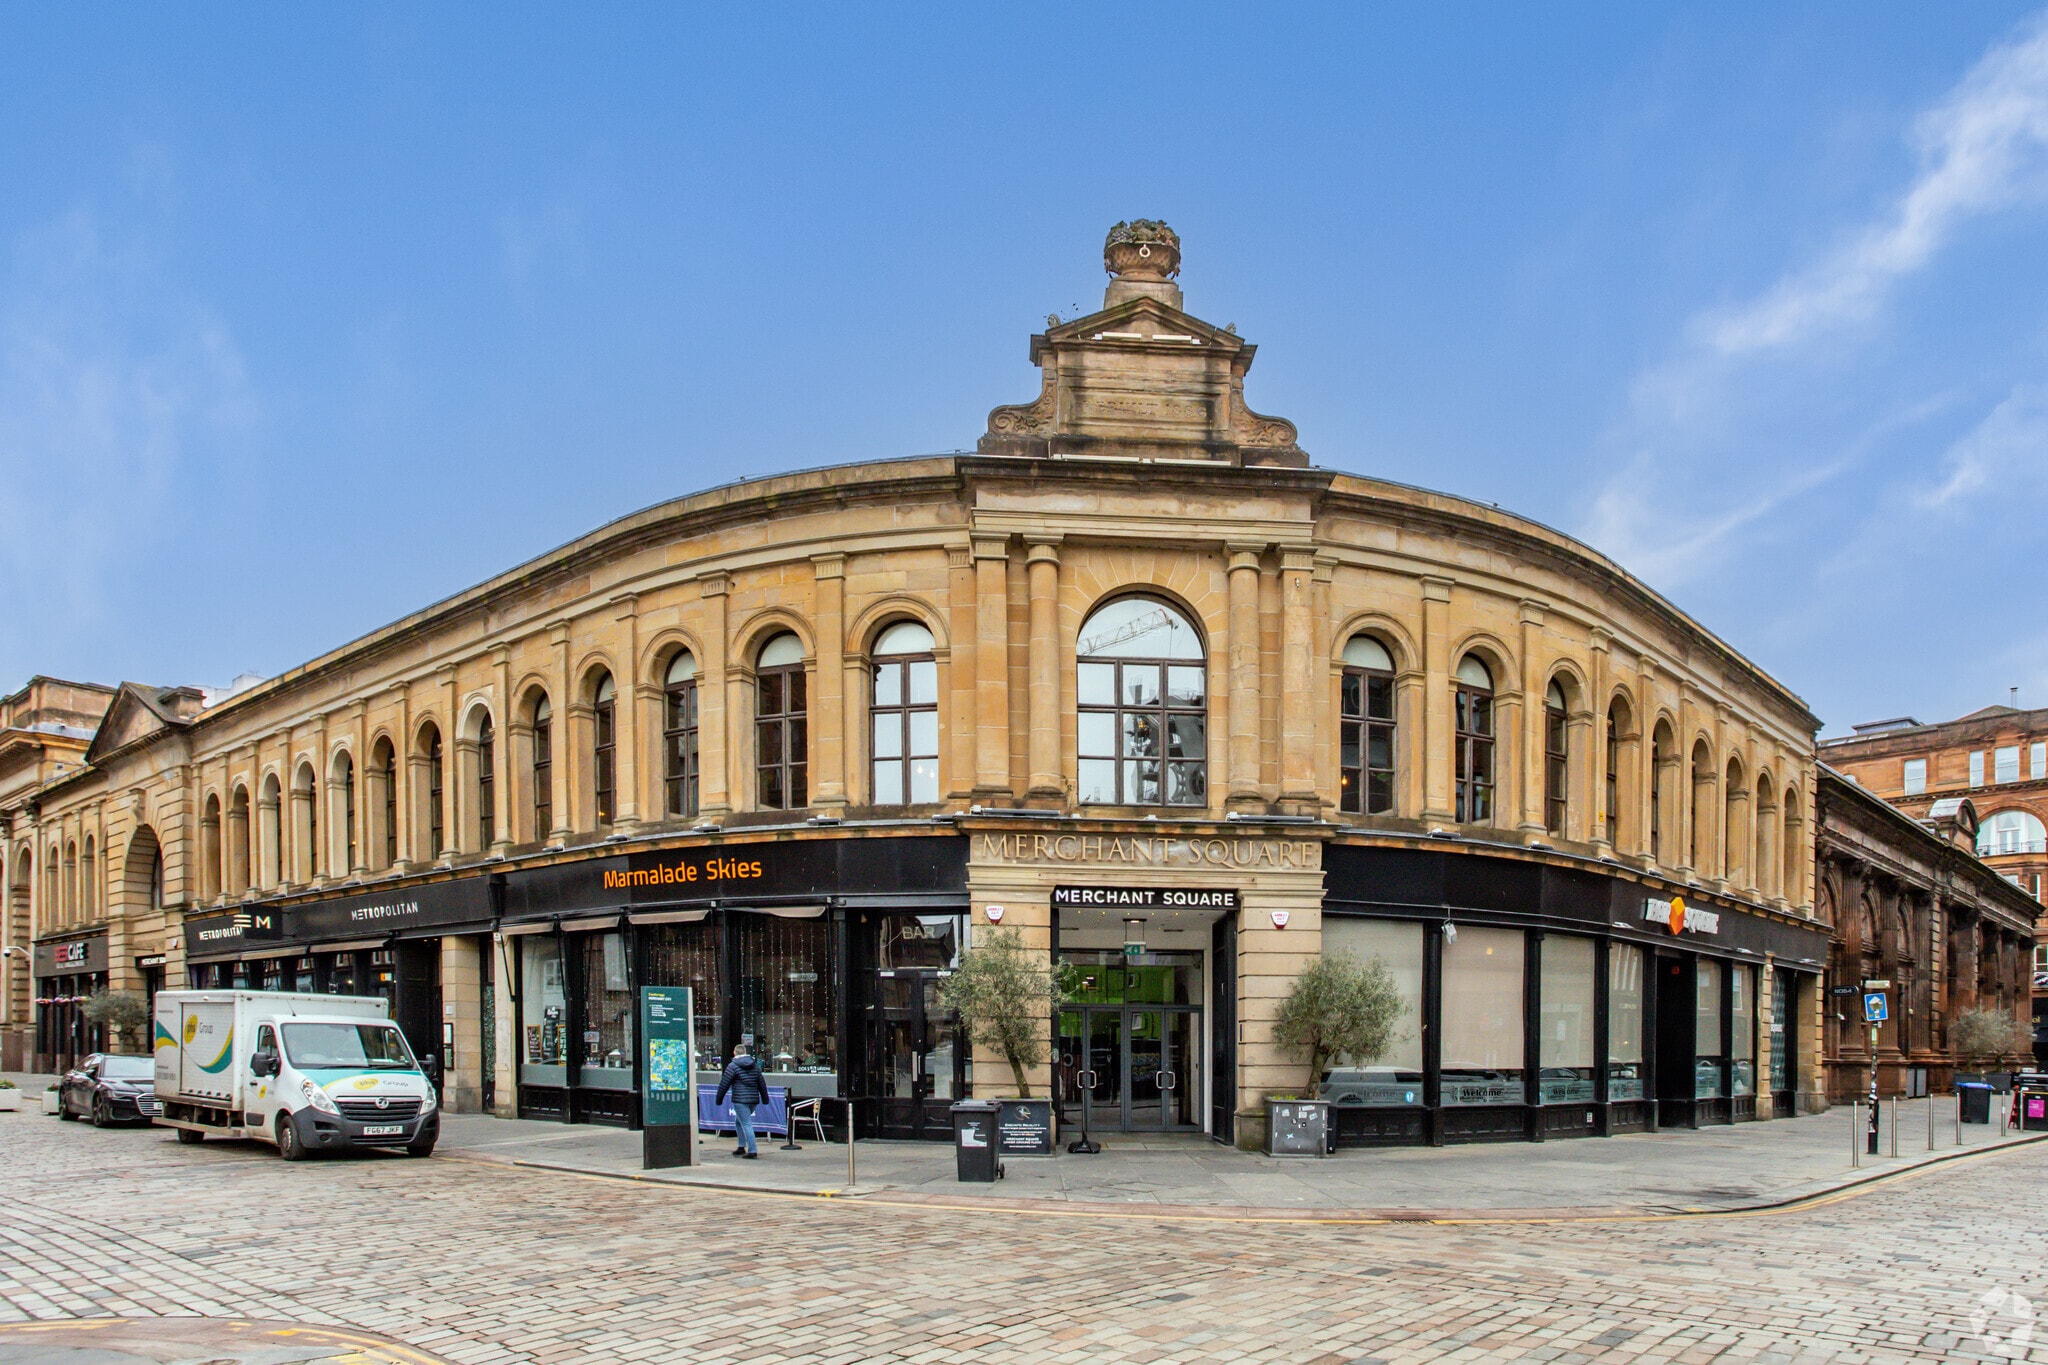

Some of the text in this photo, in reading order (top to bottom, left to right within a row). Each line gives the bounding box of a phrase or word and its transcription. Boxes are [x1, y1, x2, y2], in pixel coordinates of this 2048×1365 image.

[981, 833, 1316, 870] MERCHANT SQUARE
[604, 857, 762, 889] Marmalade Skies
[1055, 889, 1235, 907] MERCHANT SQUARE
[351, 902, 419, 921] METROPOLITAN
[902, 926, 935, 940] BAR
[199, 1021, 214, 1035] Group
[1462, 1088, 1502, 1098] Welcome
